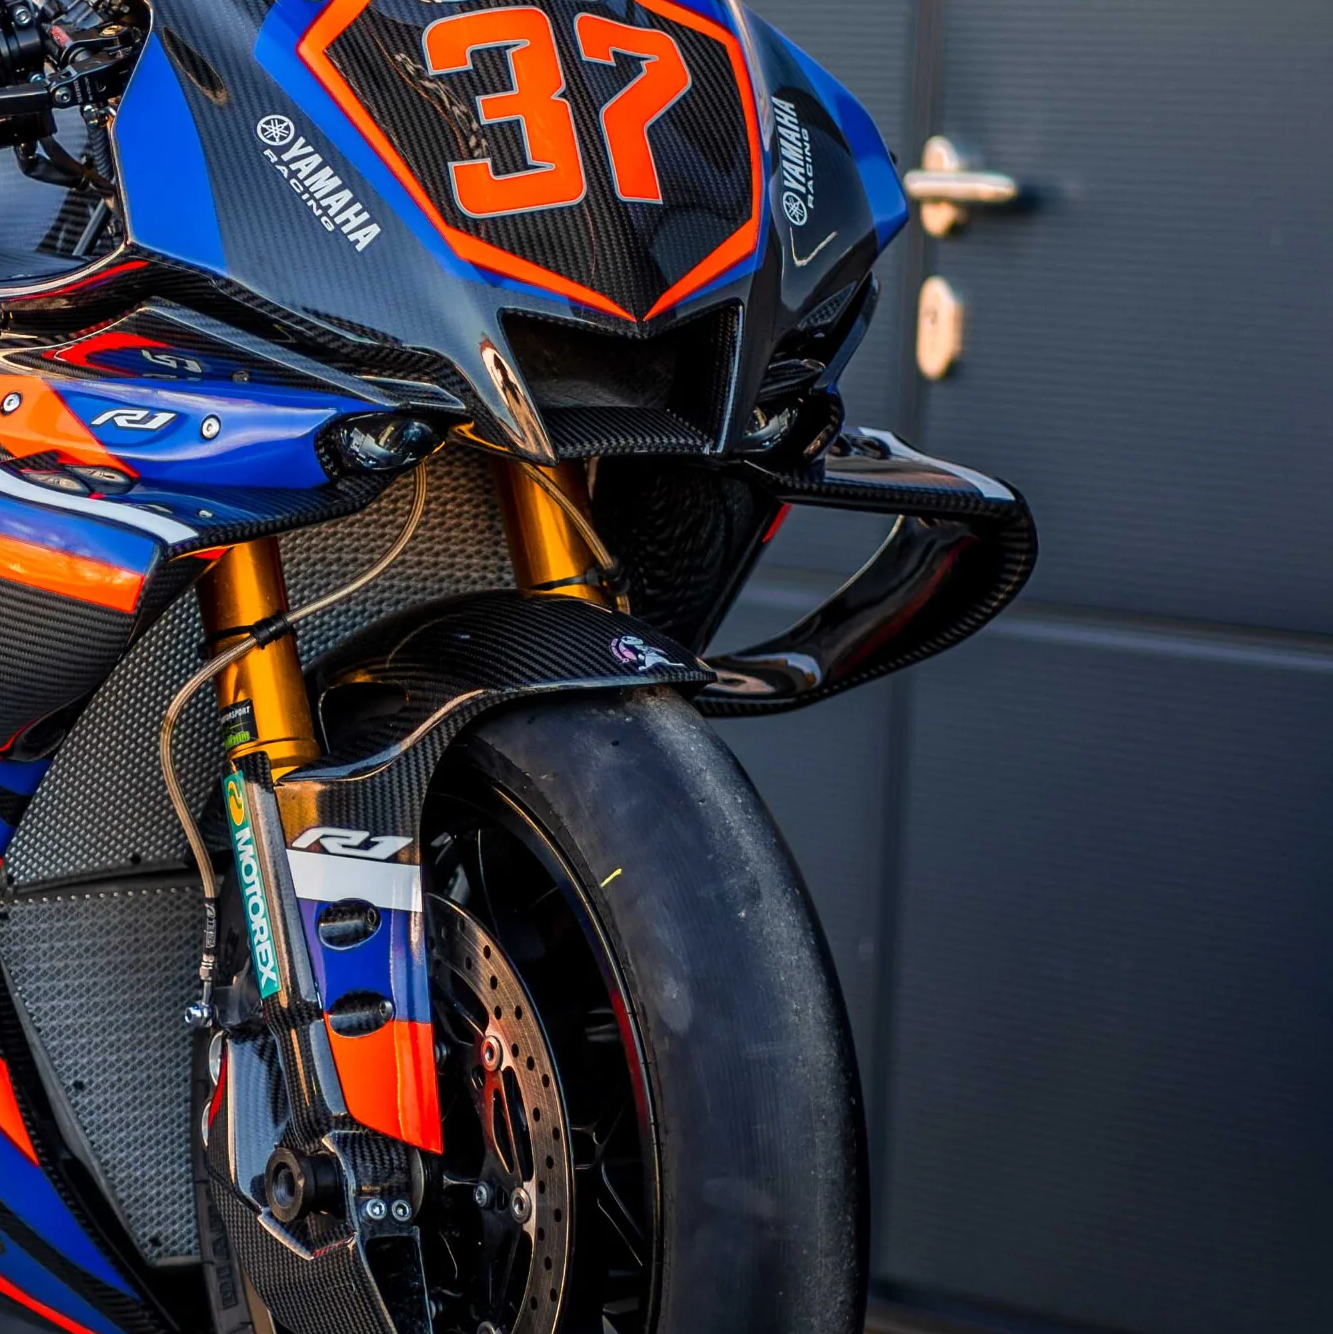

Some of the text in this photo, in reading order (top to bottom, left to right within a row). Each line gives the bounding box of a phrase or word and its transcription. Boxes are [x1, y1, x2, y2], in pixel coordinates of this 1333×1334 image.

[422, 5, 692, 218] 37
[771, 96, 807, 194] YAMAHA
[263, 149, 335, 232] RACING
[280, 136, 382, 253] YAMAHA
[800, 127, 815, 209] RACING
[90, 408, 178, 430] R1
[291, 827, 414, 860] R1
[234, 827, 278, 989] MOTOREX
